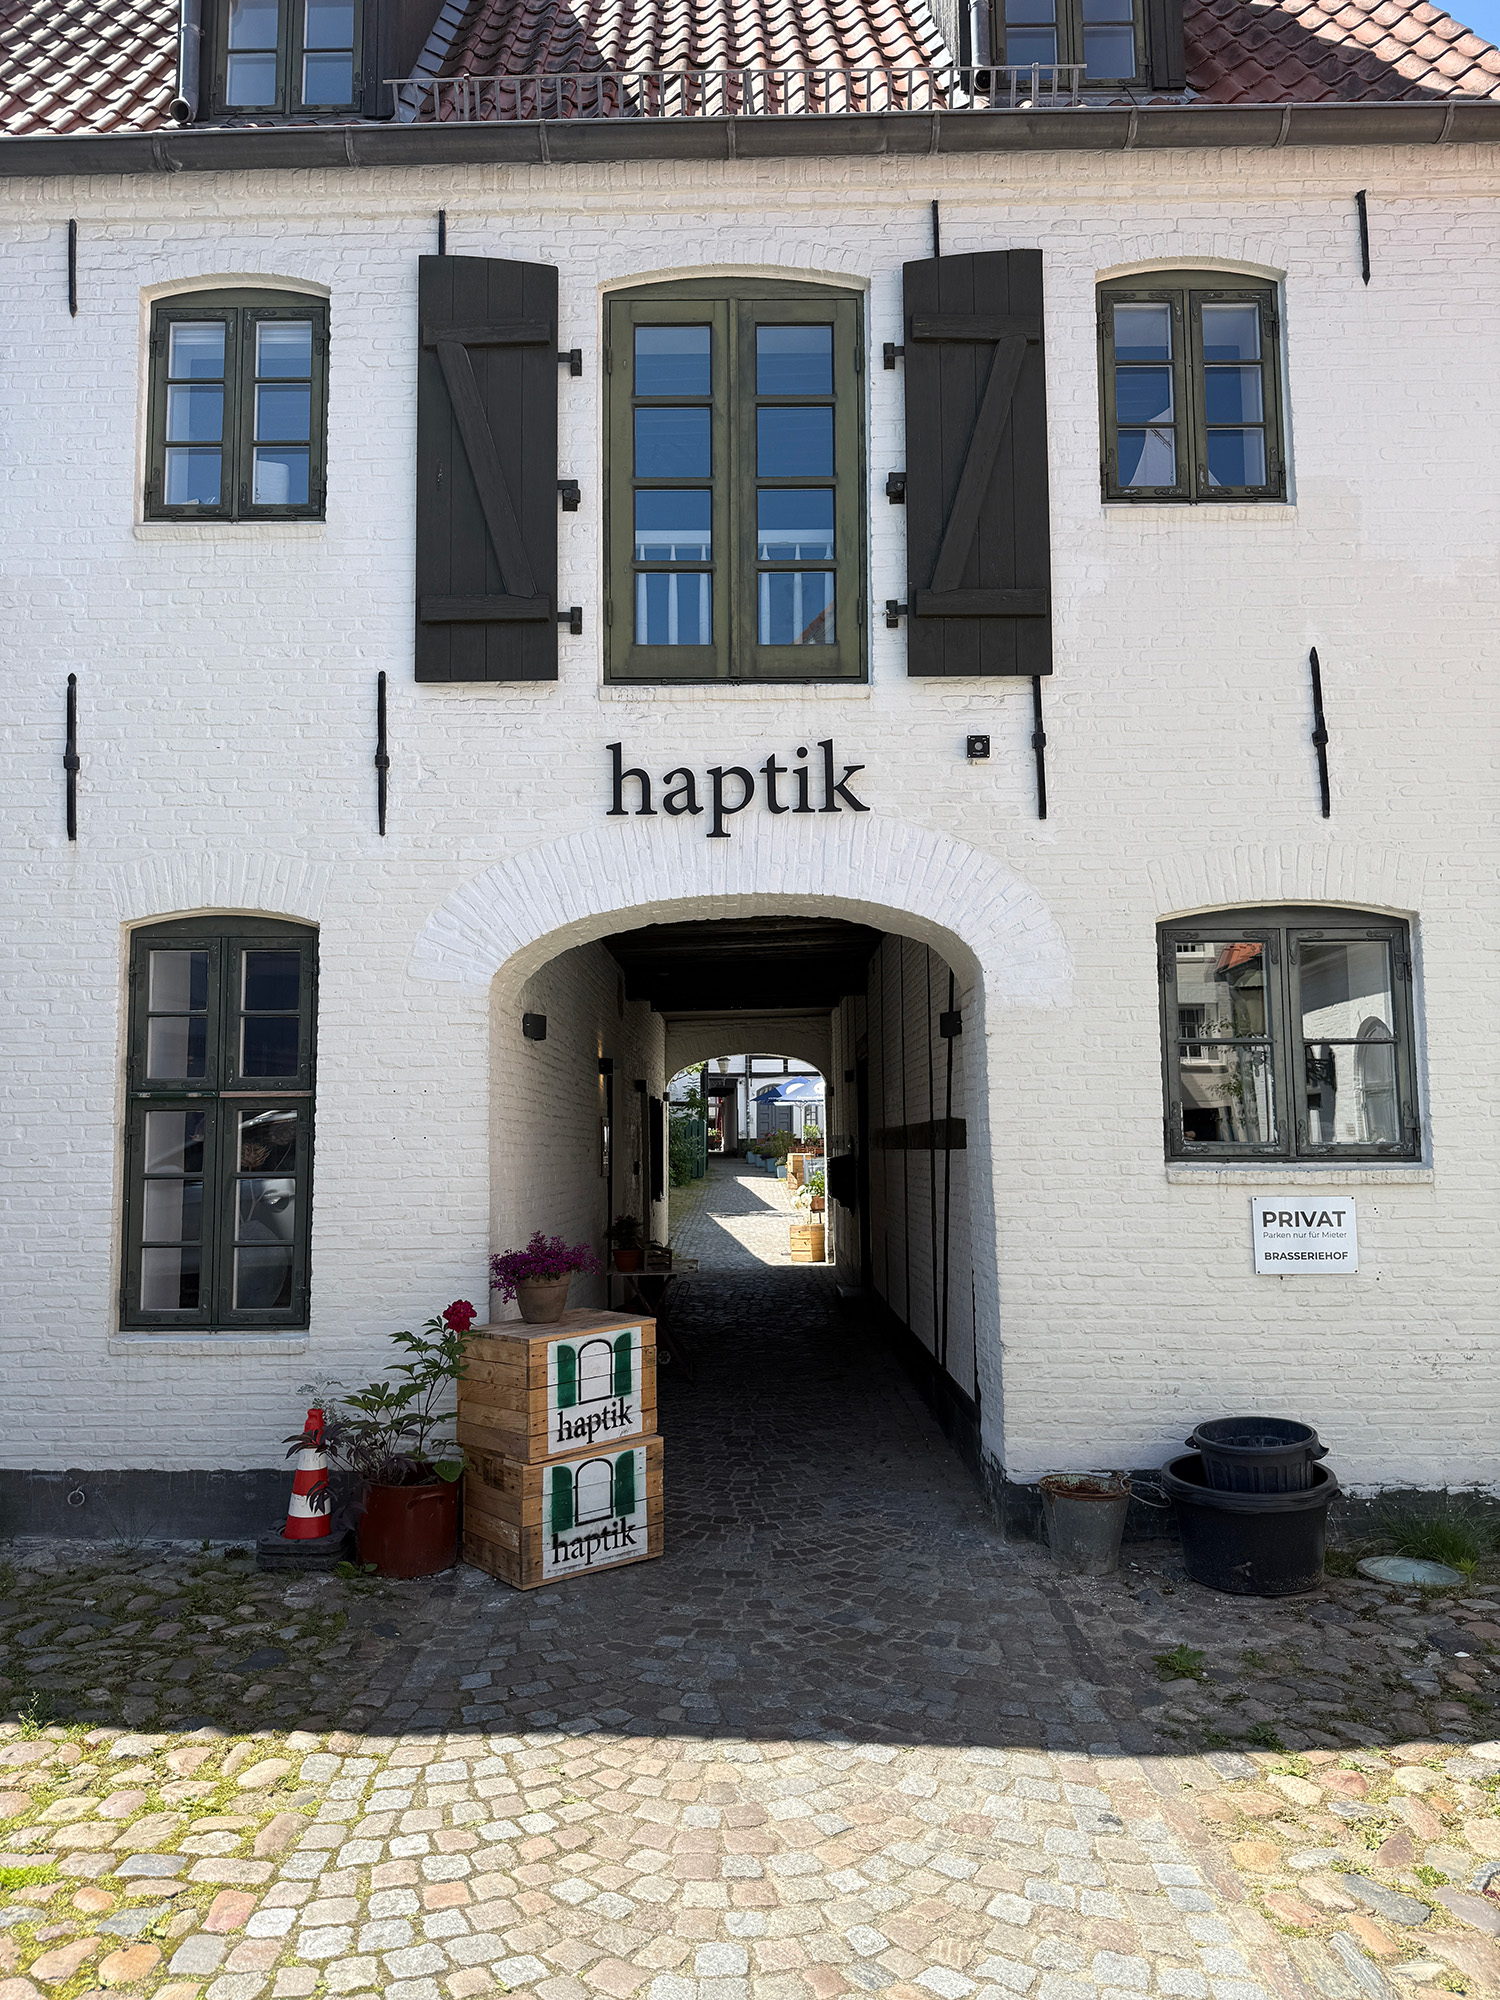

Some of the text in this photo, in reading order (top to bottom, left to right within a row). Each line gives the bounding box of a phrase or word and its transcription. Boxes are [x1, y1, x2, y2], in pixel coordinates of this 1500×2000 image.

[605, 738, 871, 838] haptik
[1262, 1210, 1346, 1228] PRIVAT
[1263, 1230, 1347, 1239] Parken nur für Mieter
[1264, 1251, 1349, 1261] BRASSERIEHOF
[556, 1397, 634, 1445] haptik
[551, 1516, 637, 1566] haptik
